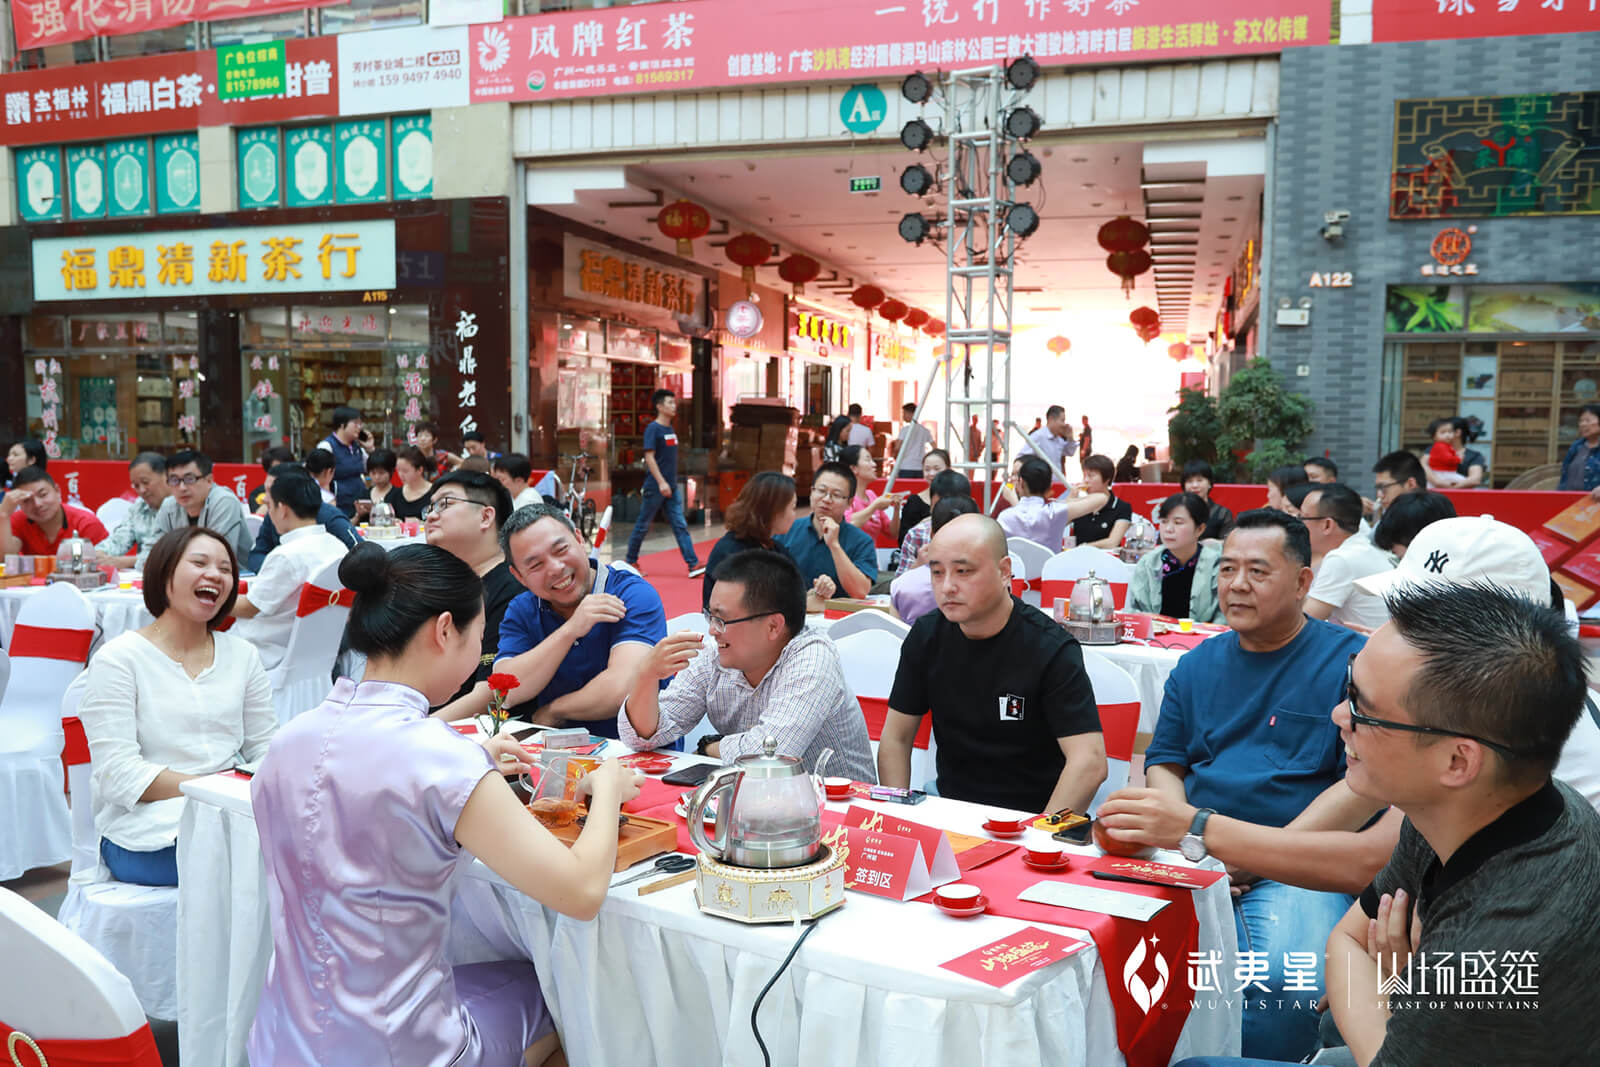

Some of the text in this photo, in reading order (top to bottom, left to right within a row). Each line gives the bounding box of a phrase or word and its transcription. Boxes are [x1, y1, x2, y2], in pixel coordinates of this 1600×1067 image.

[528, 12, 695, 60] 凤牌红茶
[226, 76, 280, 94] 81578966
[379, 74, 400, 87] 159
[403, 71, 430, 84] 9497
[433, 68, 462, 81] 4940
[34, 85, 89, 113] 宝福林
[60, 232, 362, 291] 福鼎清新茶行
[1309, 272, 1353, 287] A122
[455, 310, 480, 459] 福鼎老白
[1424, 549, 1450, 574] NY
[854, 867, 894, 889] 签到区
